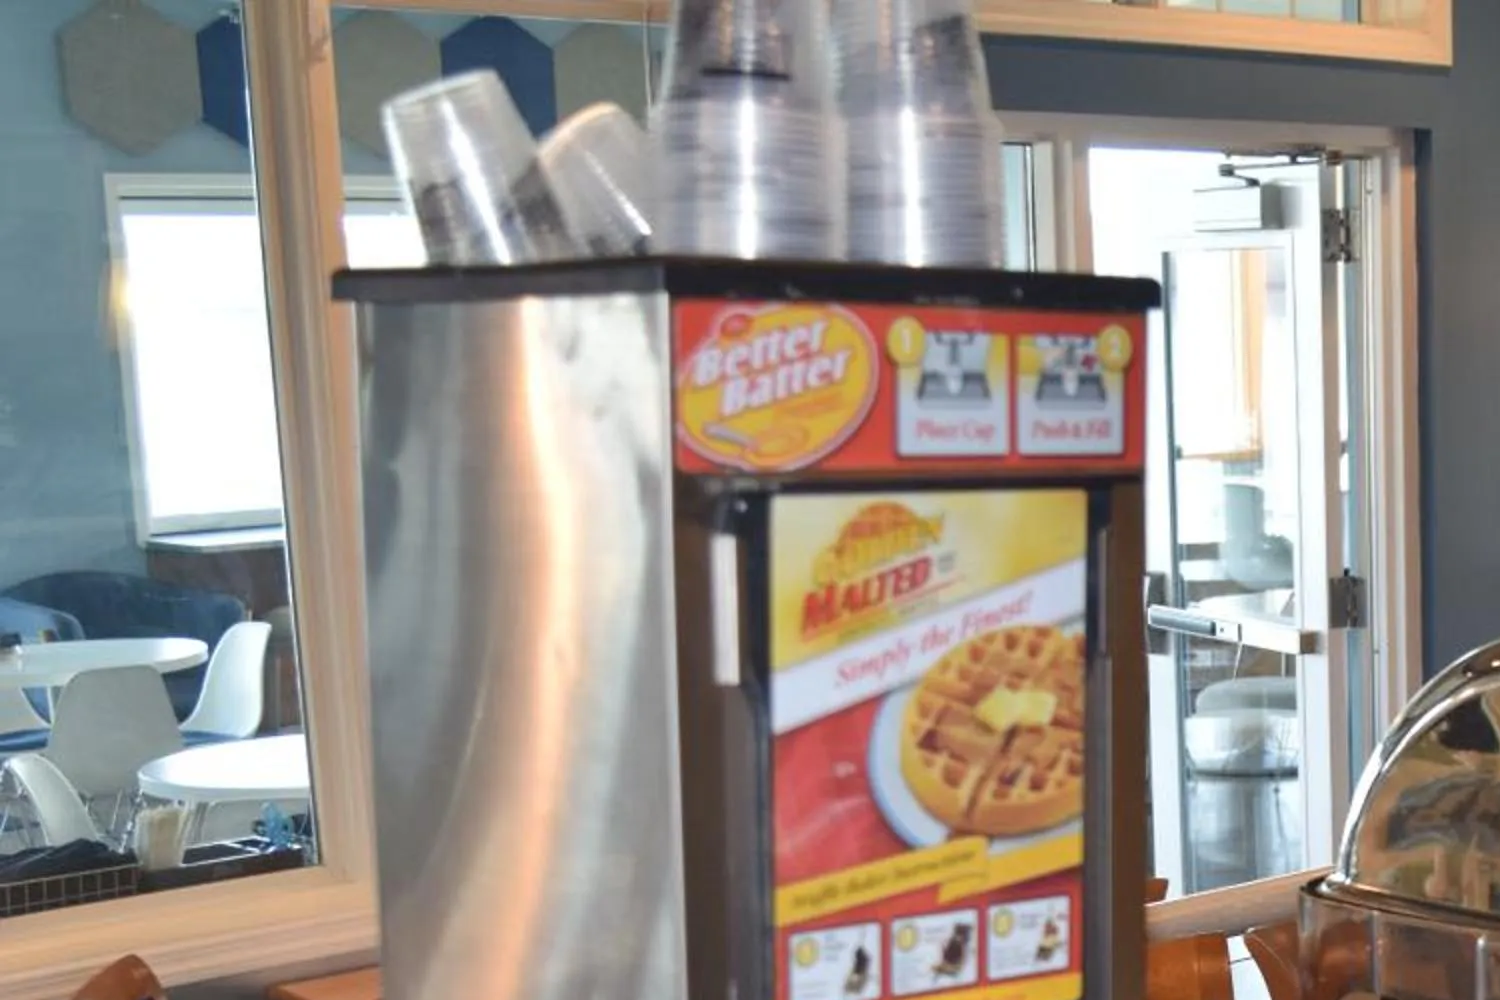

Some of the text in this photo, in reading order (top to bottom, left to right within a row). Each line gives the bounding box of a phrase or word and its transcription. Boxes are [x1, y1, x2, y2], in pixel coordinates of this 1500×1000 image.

[694, 318, 828, 387] Better
[901, 327, 912, 354] 1
[720, 348, 852, 417] Batter
[801, 555, 932, 638] MALTED
